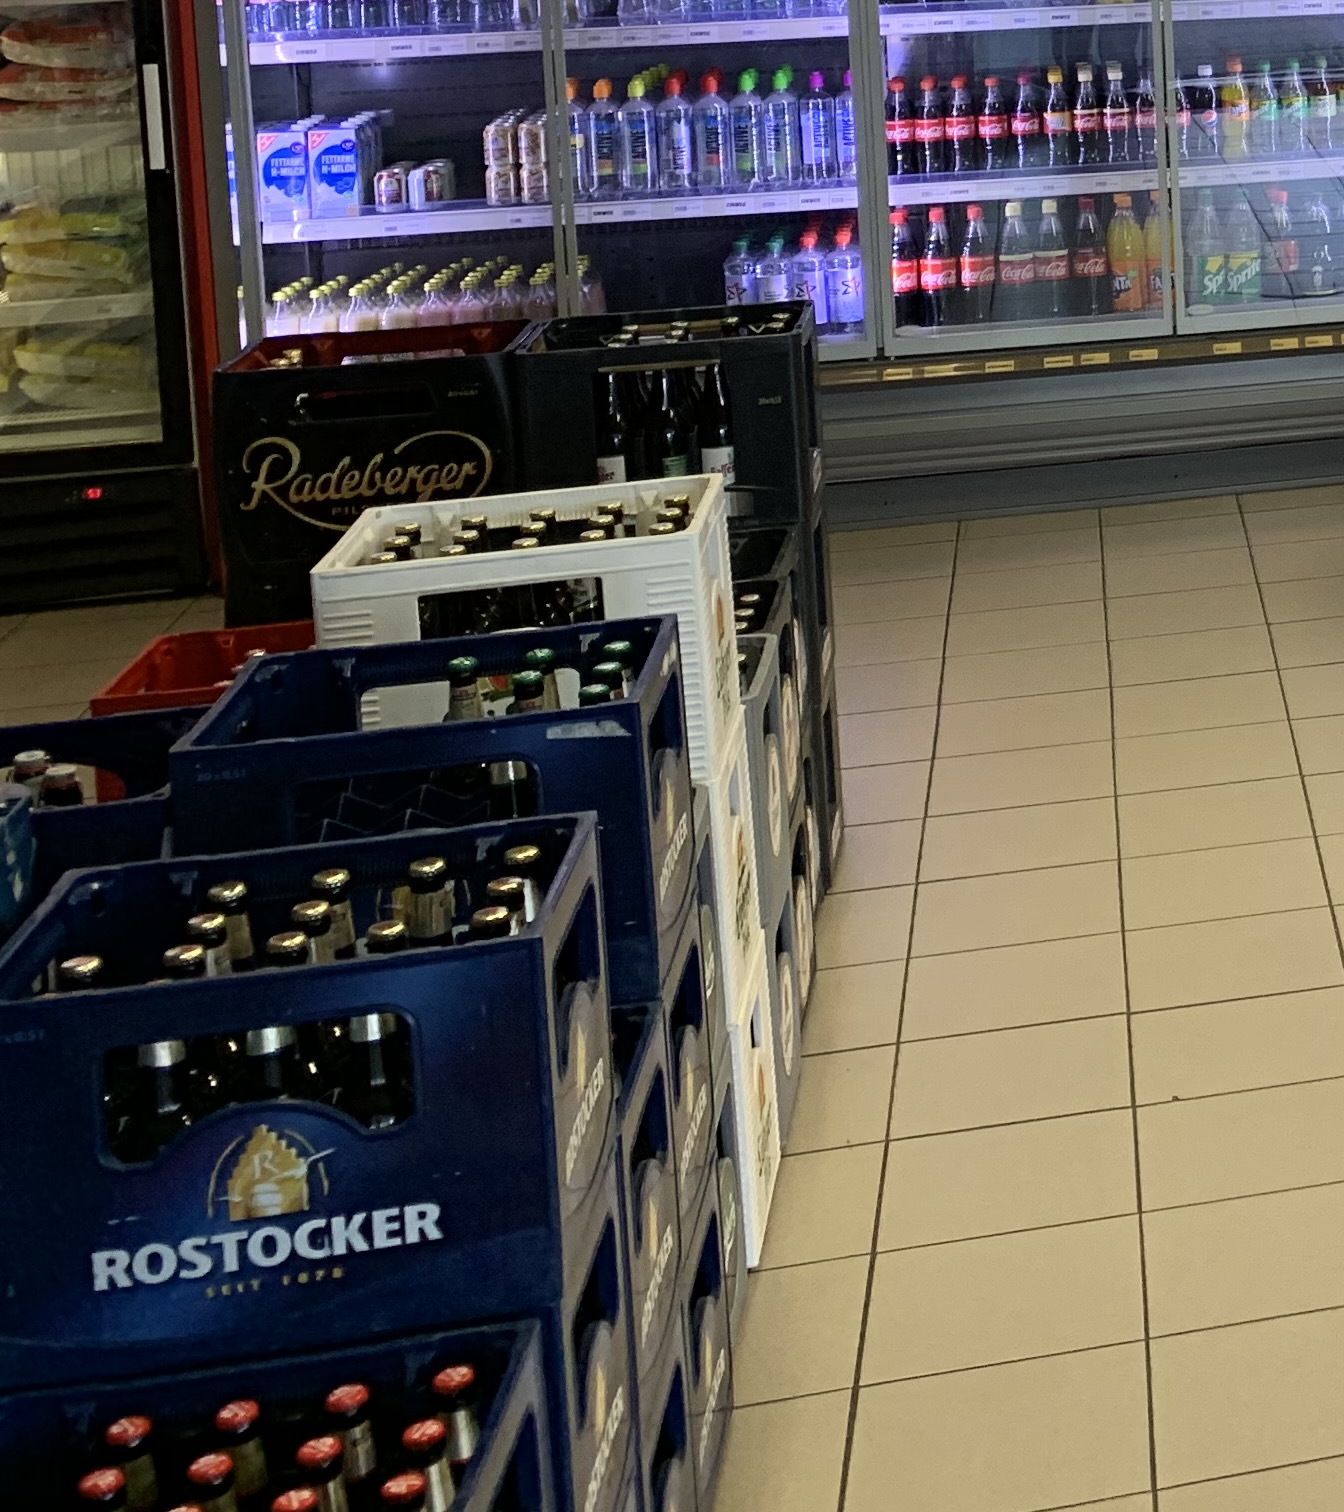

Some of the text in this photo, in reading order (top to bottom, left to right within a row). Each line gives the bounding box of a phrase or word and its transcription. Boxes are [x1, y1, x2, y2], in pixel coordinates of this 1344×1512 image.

[240, 434, 486, 512] Radeberger
[91, 1200, 445, 1292] ROSTOCKER
[206, 1277, 261, 1299] SEIT
